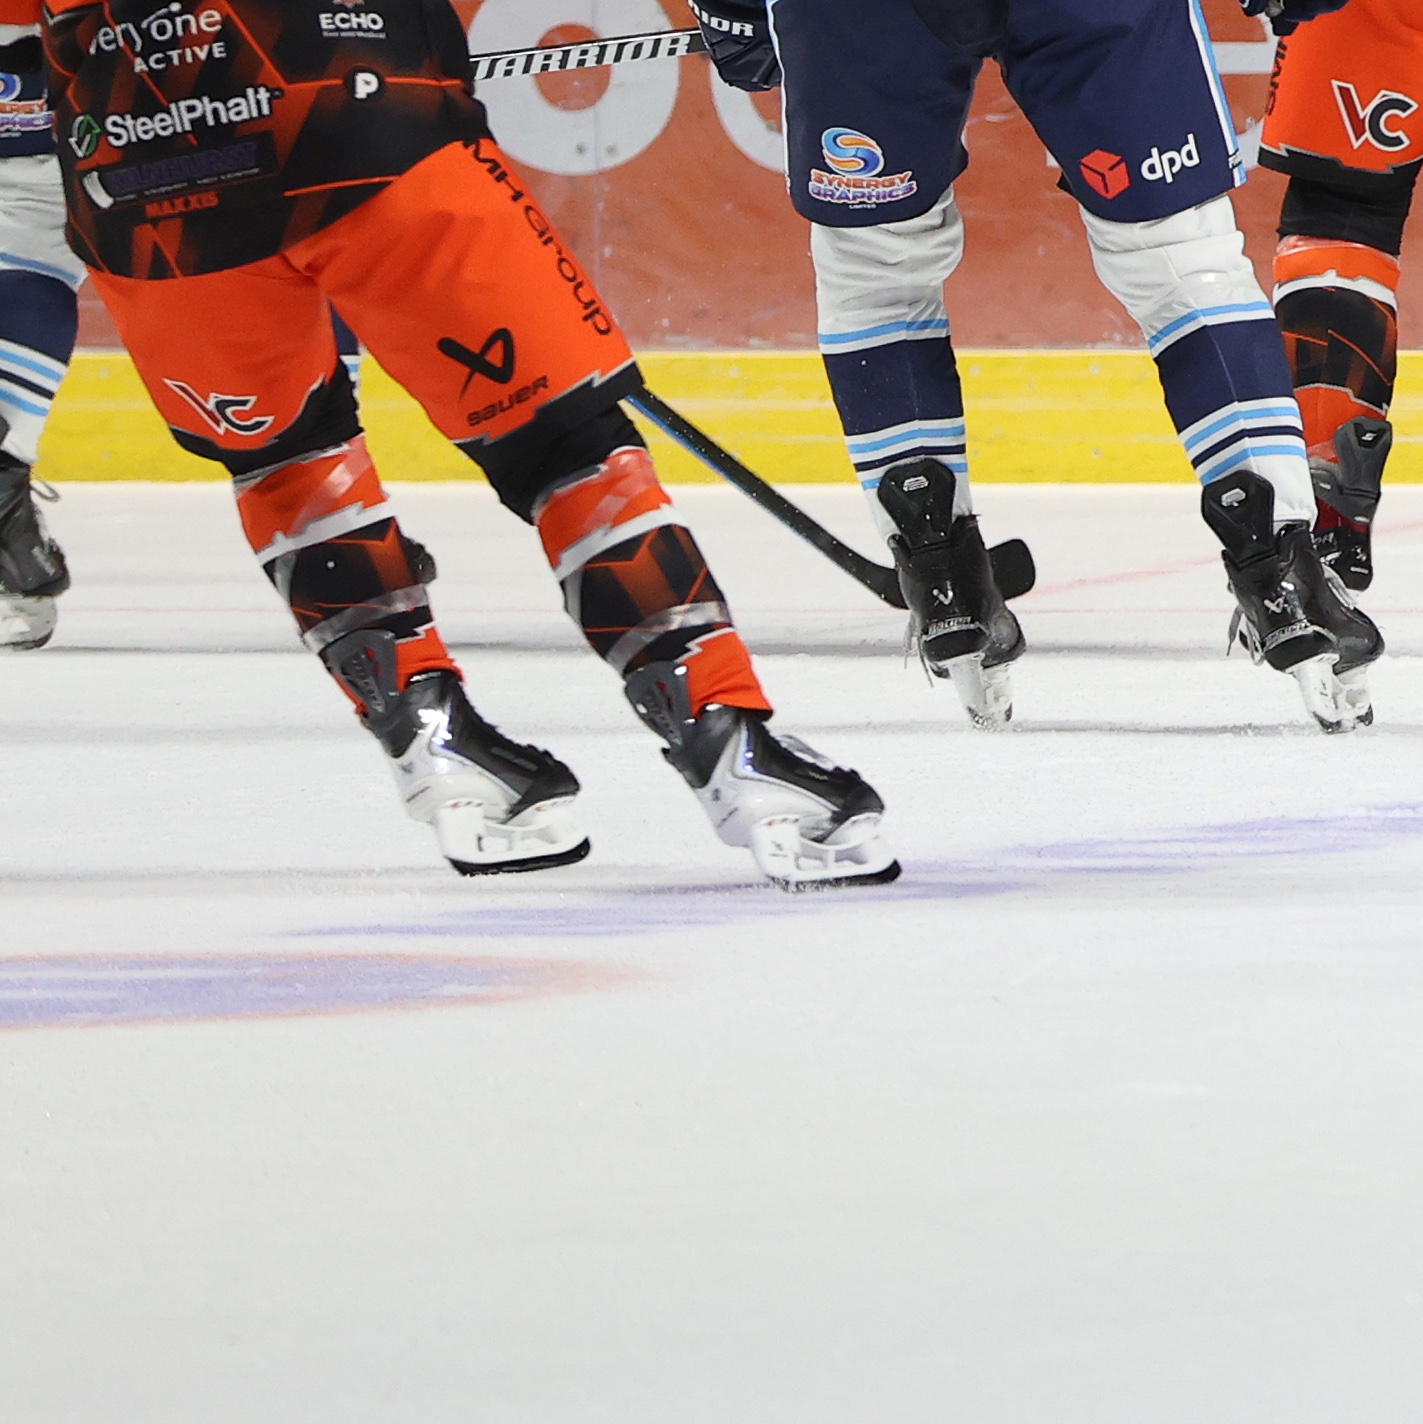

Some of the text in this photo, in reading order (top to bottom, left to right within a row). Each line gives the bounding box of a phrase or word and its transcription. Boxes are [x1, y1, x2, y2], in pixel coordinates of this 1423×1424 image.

[319, 12, 385, 30] ECHO
[134, 41, 228, 74] ACTIVE
[105, 86, 272, 148] SteelPhalt
[1140, 133, 1200, 183] dpd
[810, 182, 917, 205] GRAPHICS
[811, 171, 911, 189] SYNERGY
[466, 377, 549, 428] BAUER
